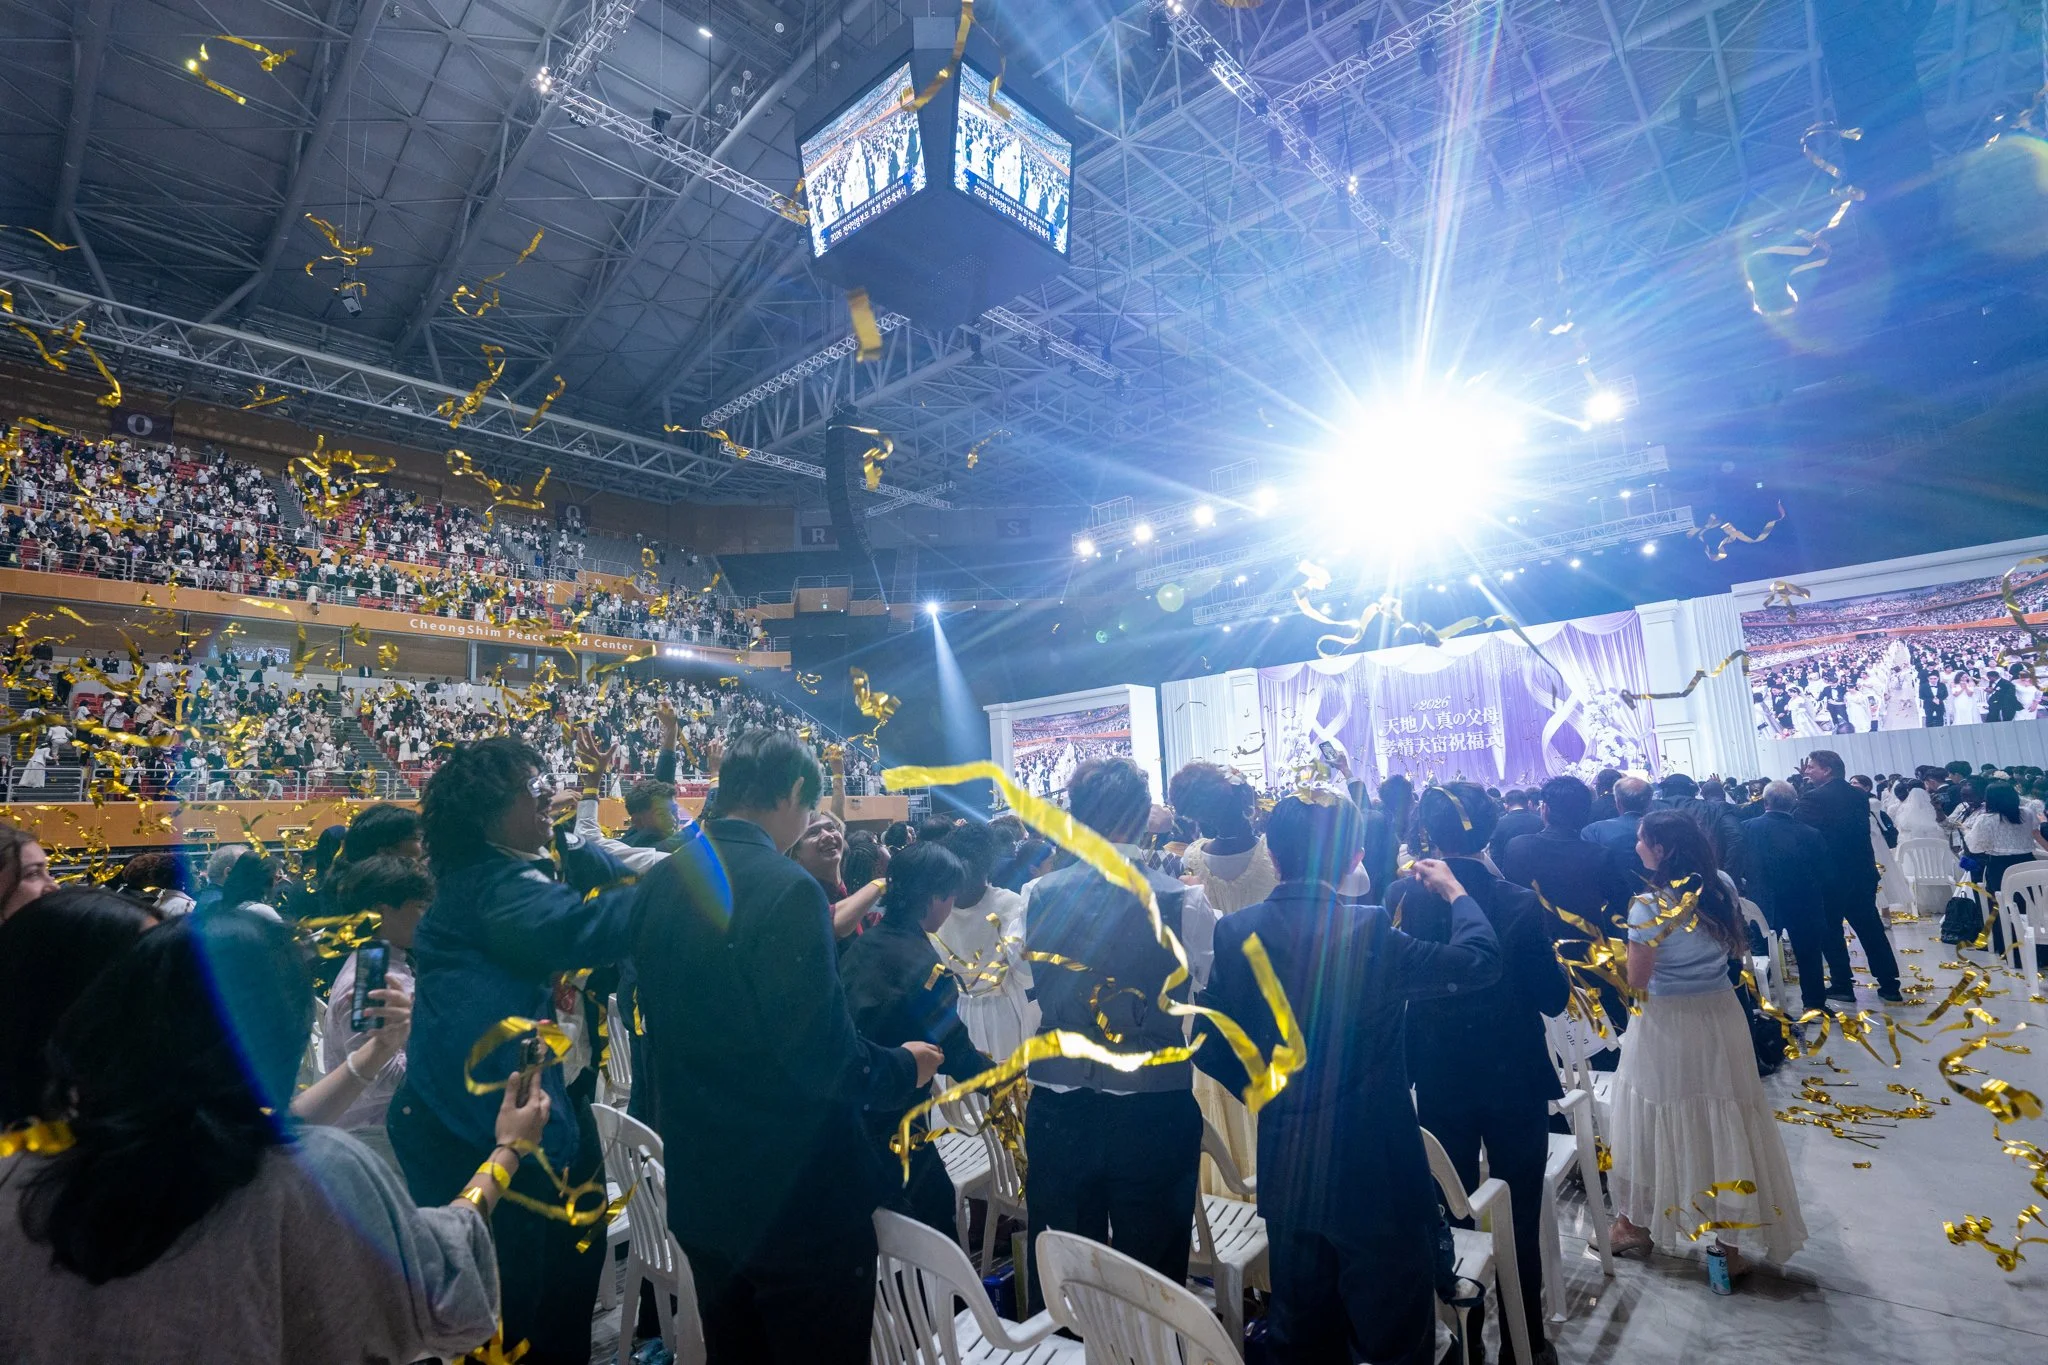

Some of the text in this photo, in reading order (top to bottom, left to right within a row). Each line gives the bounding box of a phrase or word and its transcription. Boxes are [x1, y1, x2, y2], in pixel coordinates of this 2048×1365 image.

[830, 229, 843, 243] 2026
[127, 413, 153, 436] O
[812, 527, 826, 544] R
[1007, 520, 1020, 536] S
[409, 618, 501, 637] CheongShim
[508, 629, 546, 642] Peace
[594, 639, 634, 651] Center
[1418, 695, 1452, 711] 2026
[1379, 705, 1500, 736] 天地人真の父母
